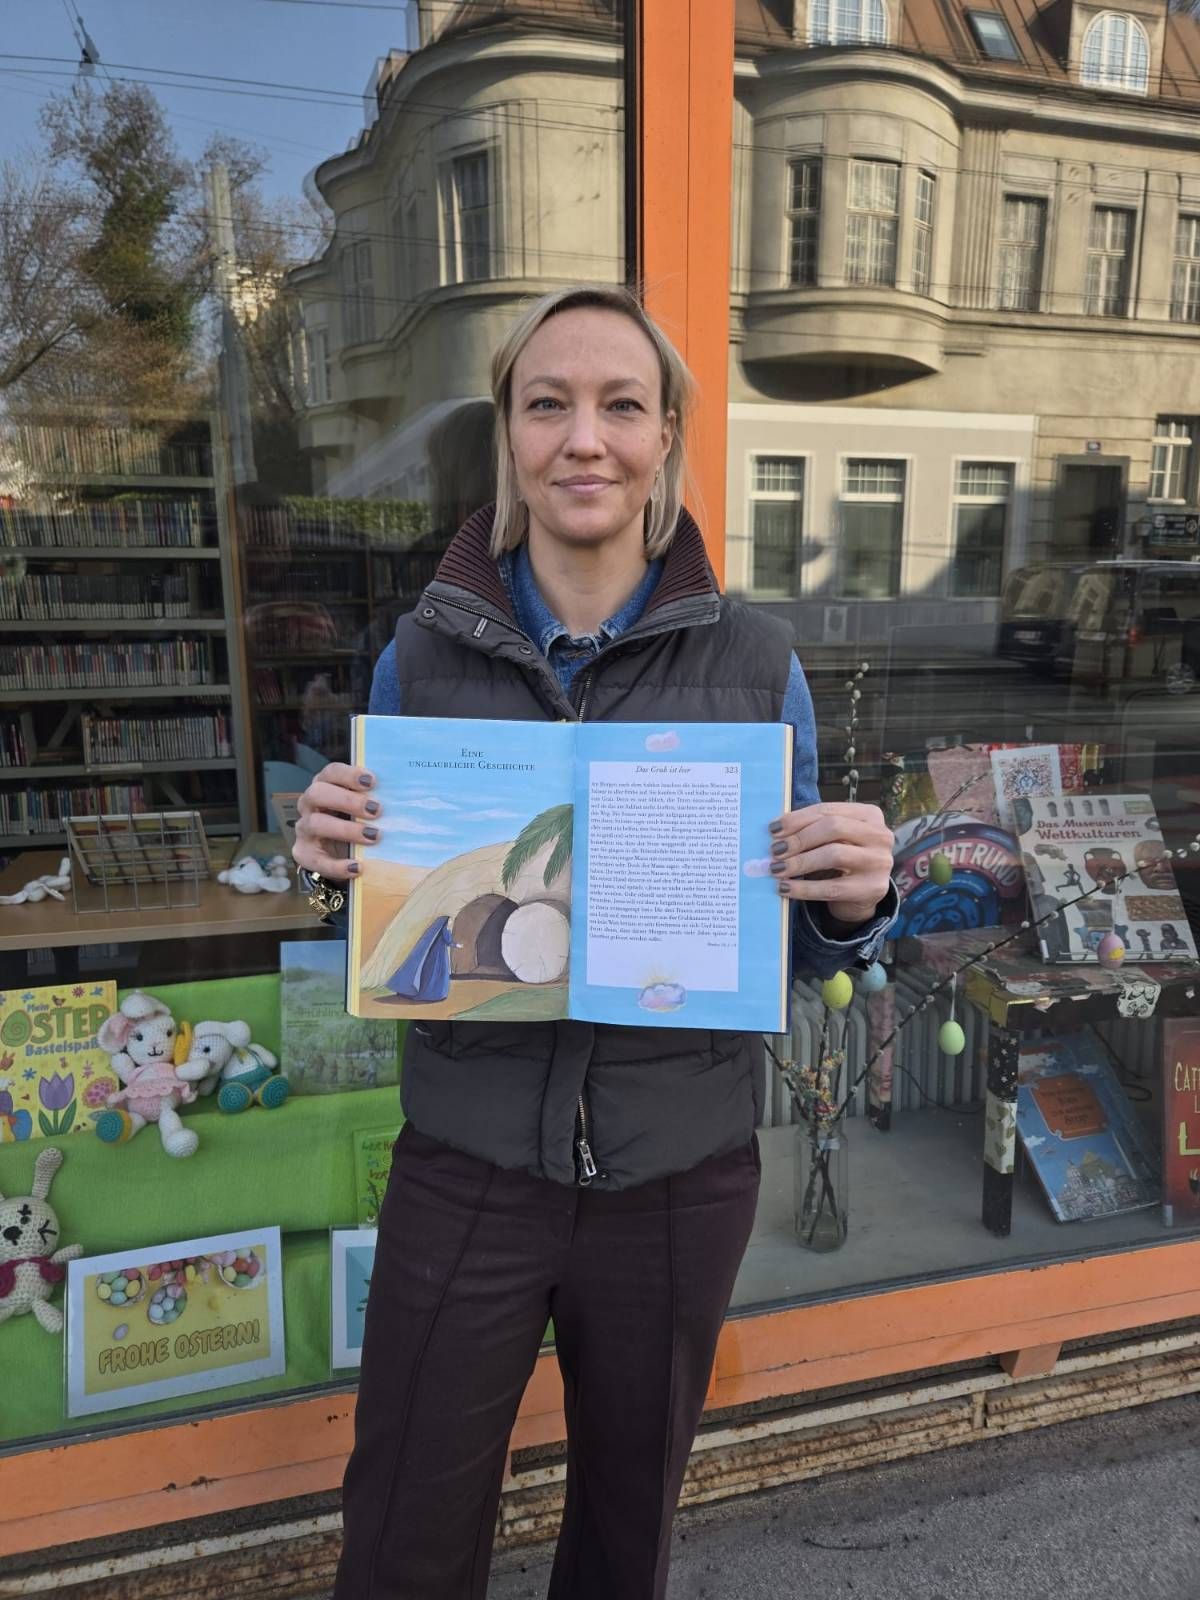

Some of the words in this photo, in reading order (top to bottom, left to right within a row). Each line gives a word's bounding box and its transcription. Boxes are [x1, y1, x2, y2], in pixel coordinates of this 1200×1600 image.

[724, 766, 739, 774] 323
[1037, 820, 1060, 829] Das
[1062, 819, 1114, 828] Museum
[1117, 818, 1136, 827] der
[1035, 829, 1142, 841] Weltkulturen
[970, 843, 1018, 887] RUND
[26, 1003, 49, 1013] Mein
[98, 1337, 170, 1375] FROHE
[174, 1319, 261, 1360] OSTERN!
